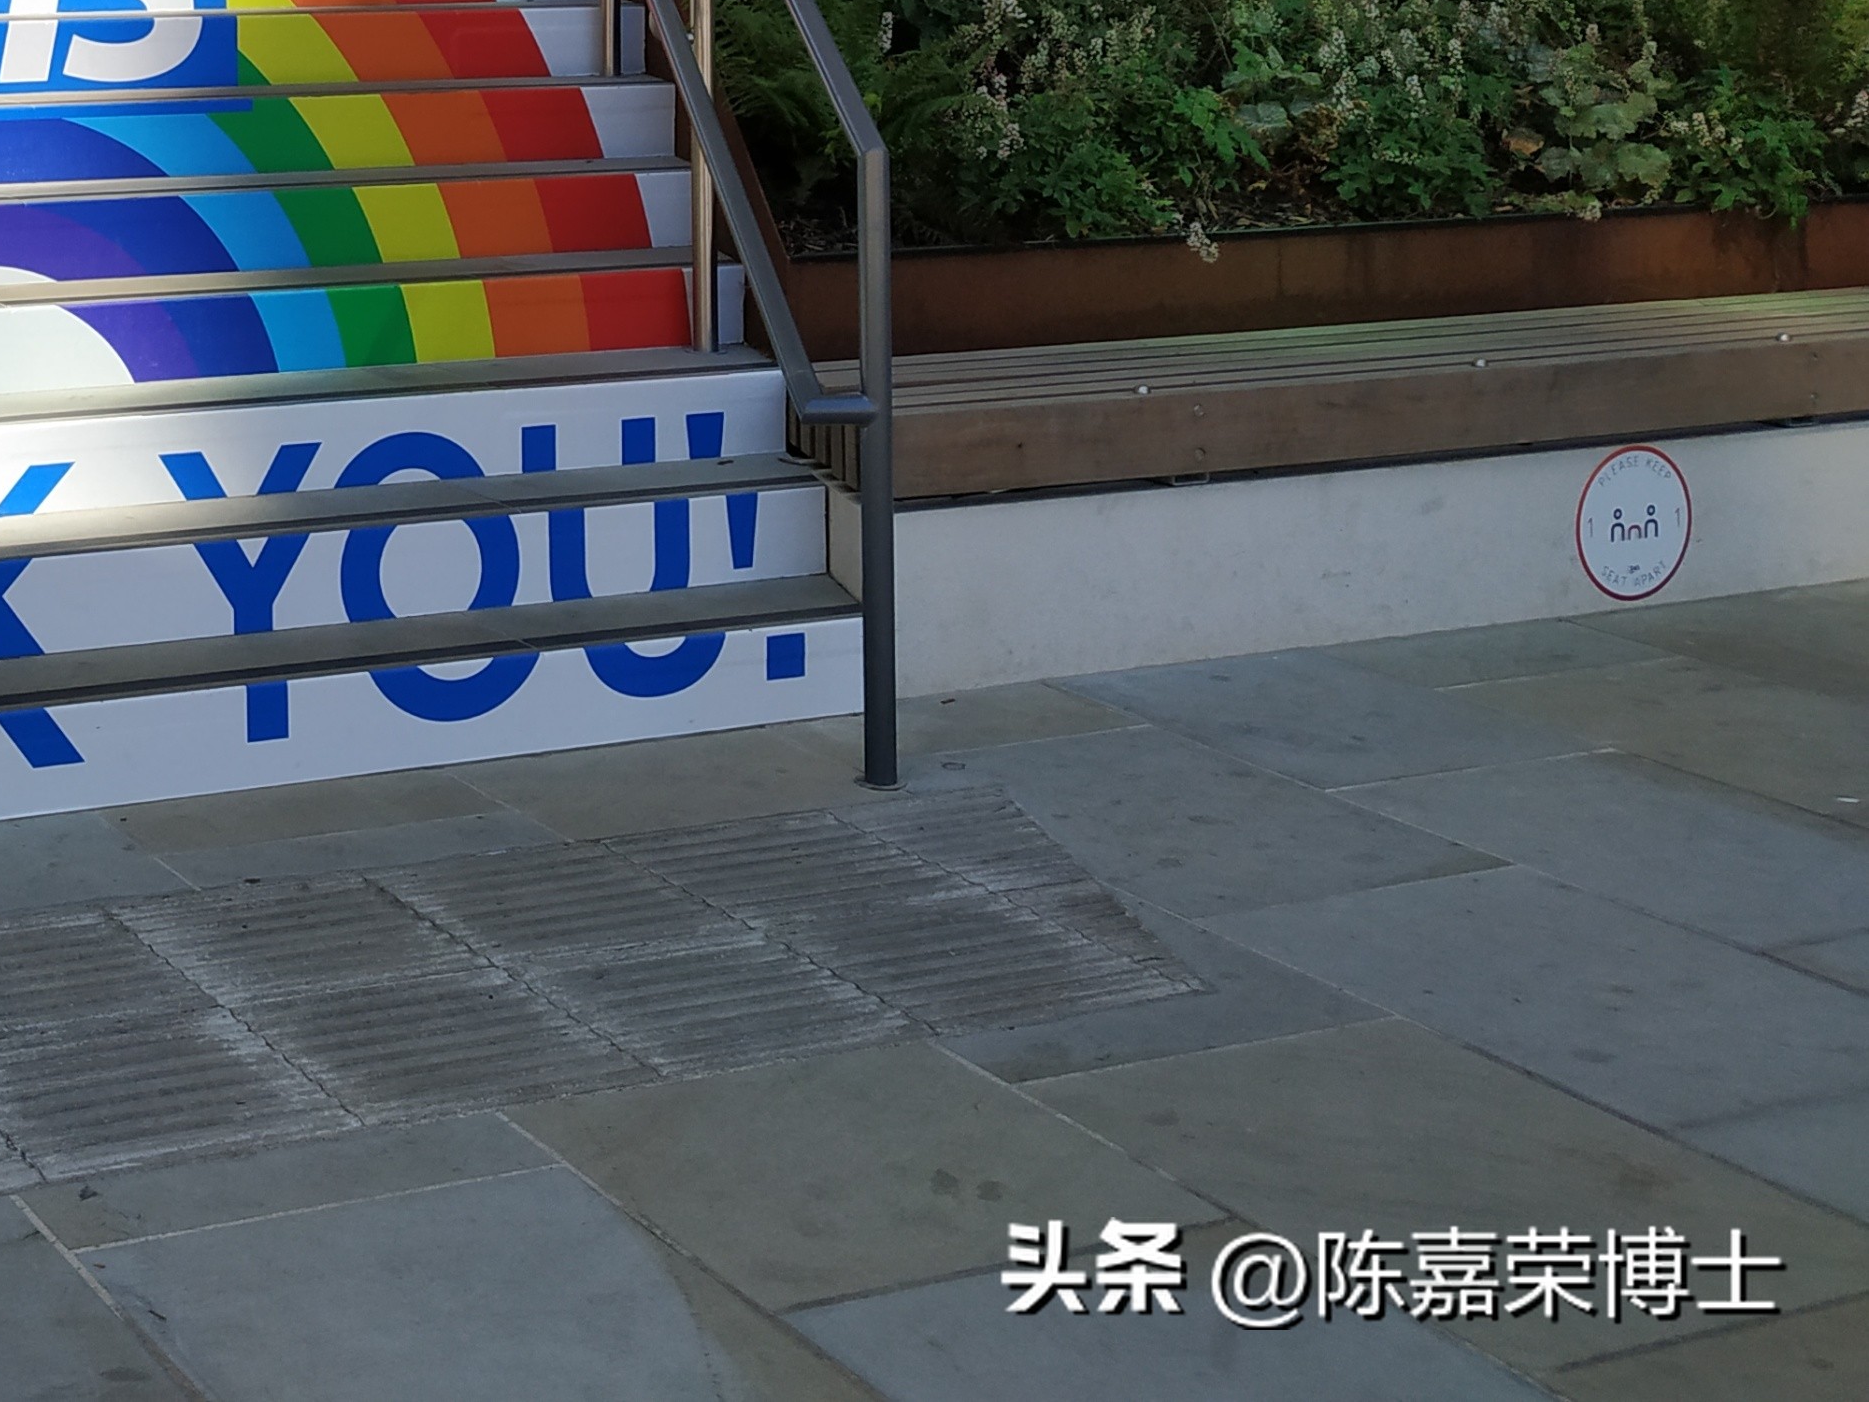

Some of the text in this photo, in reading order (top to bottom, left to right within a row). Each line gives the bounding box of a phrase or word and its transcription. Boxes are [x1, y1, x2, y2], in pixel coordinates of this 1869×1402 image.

[1597, 455, 1672, 487] PLEASE KEEP
[155, 412, 808, 744] YOU!
[1601, 565, 1628, 586] SEAT
[1634, 560, 1667, 587] APART
